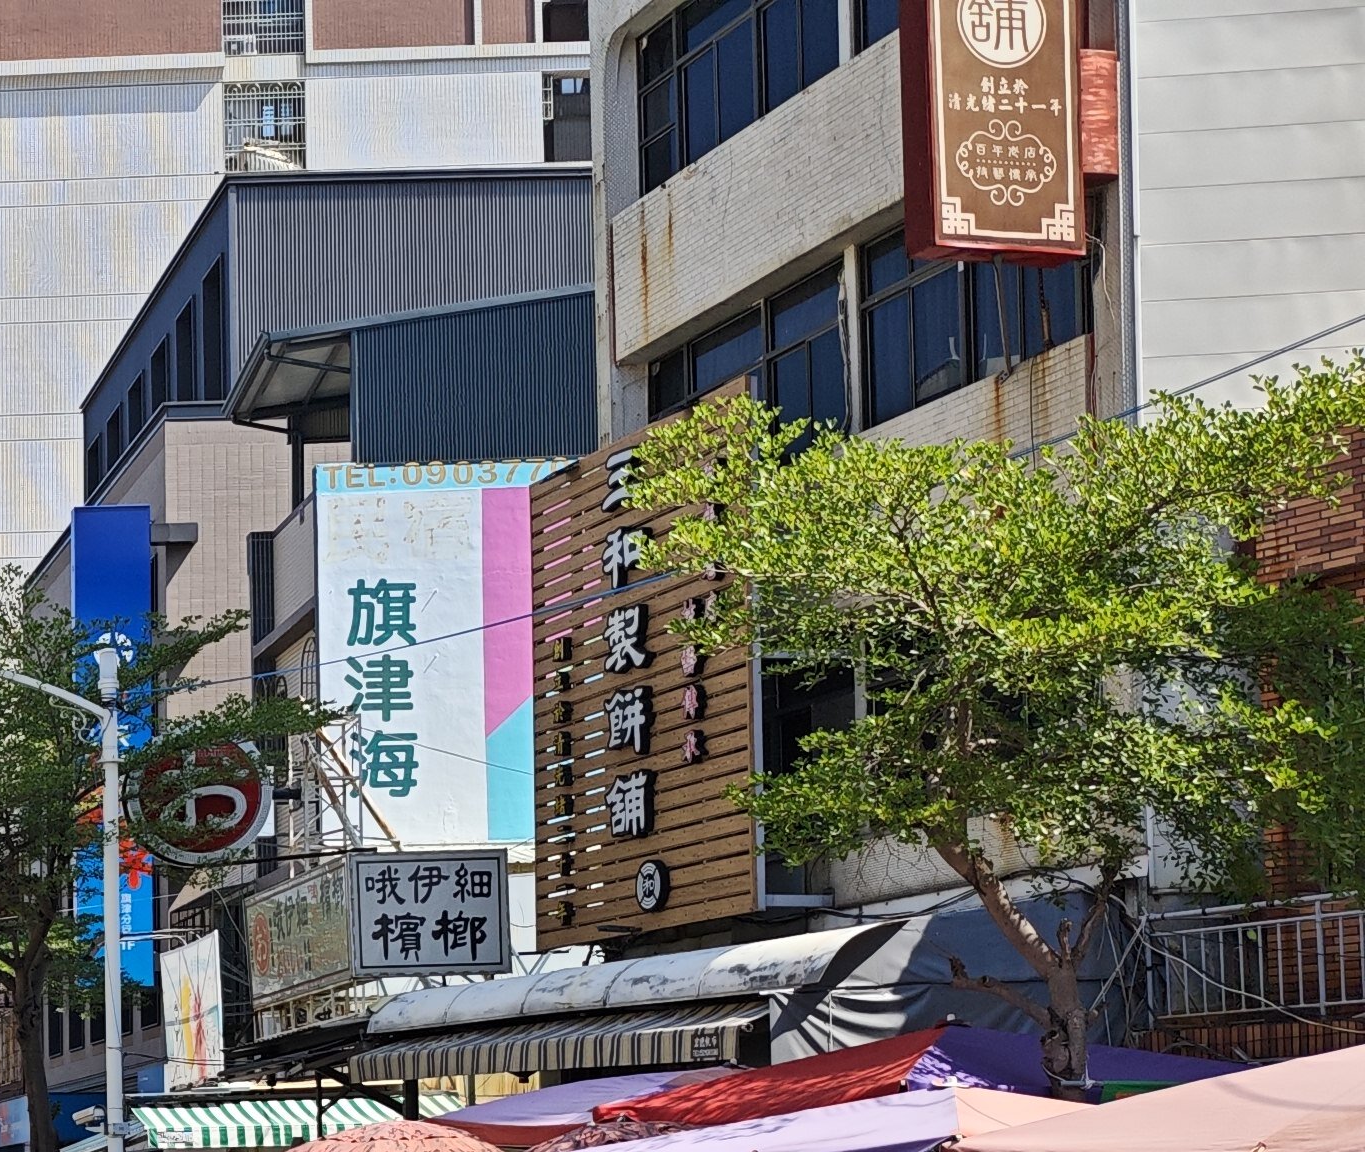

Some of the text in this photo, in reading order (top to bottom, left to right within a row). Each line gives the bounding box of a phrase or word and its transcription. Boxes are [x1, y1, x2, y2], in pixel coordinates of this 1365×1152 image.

[949, 93, 1062, 116] 清光緒二十一年
[981, 76, 1028, 95] 創立於
[346, 578, 419, 798] 旗津海
[365, 863, 493, 904] 哦伊細
[371, 909, 488, 962] 檳榔
